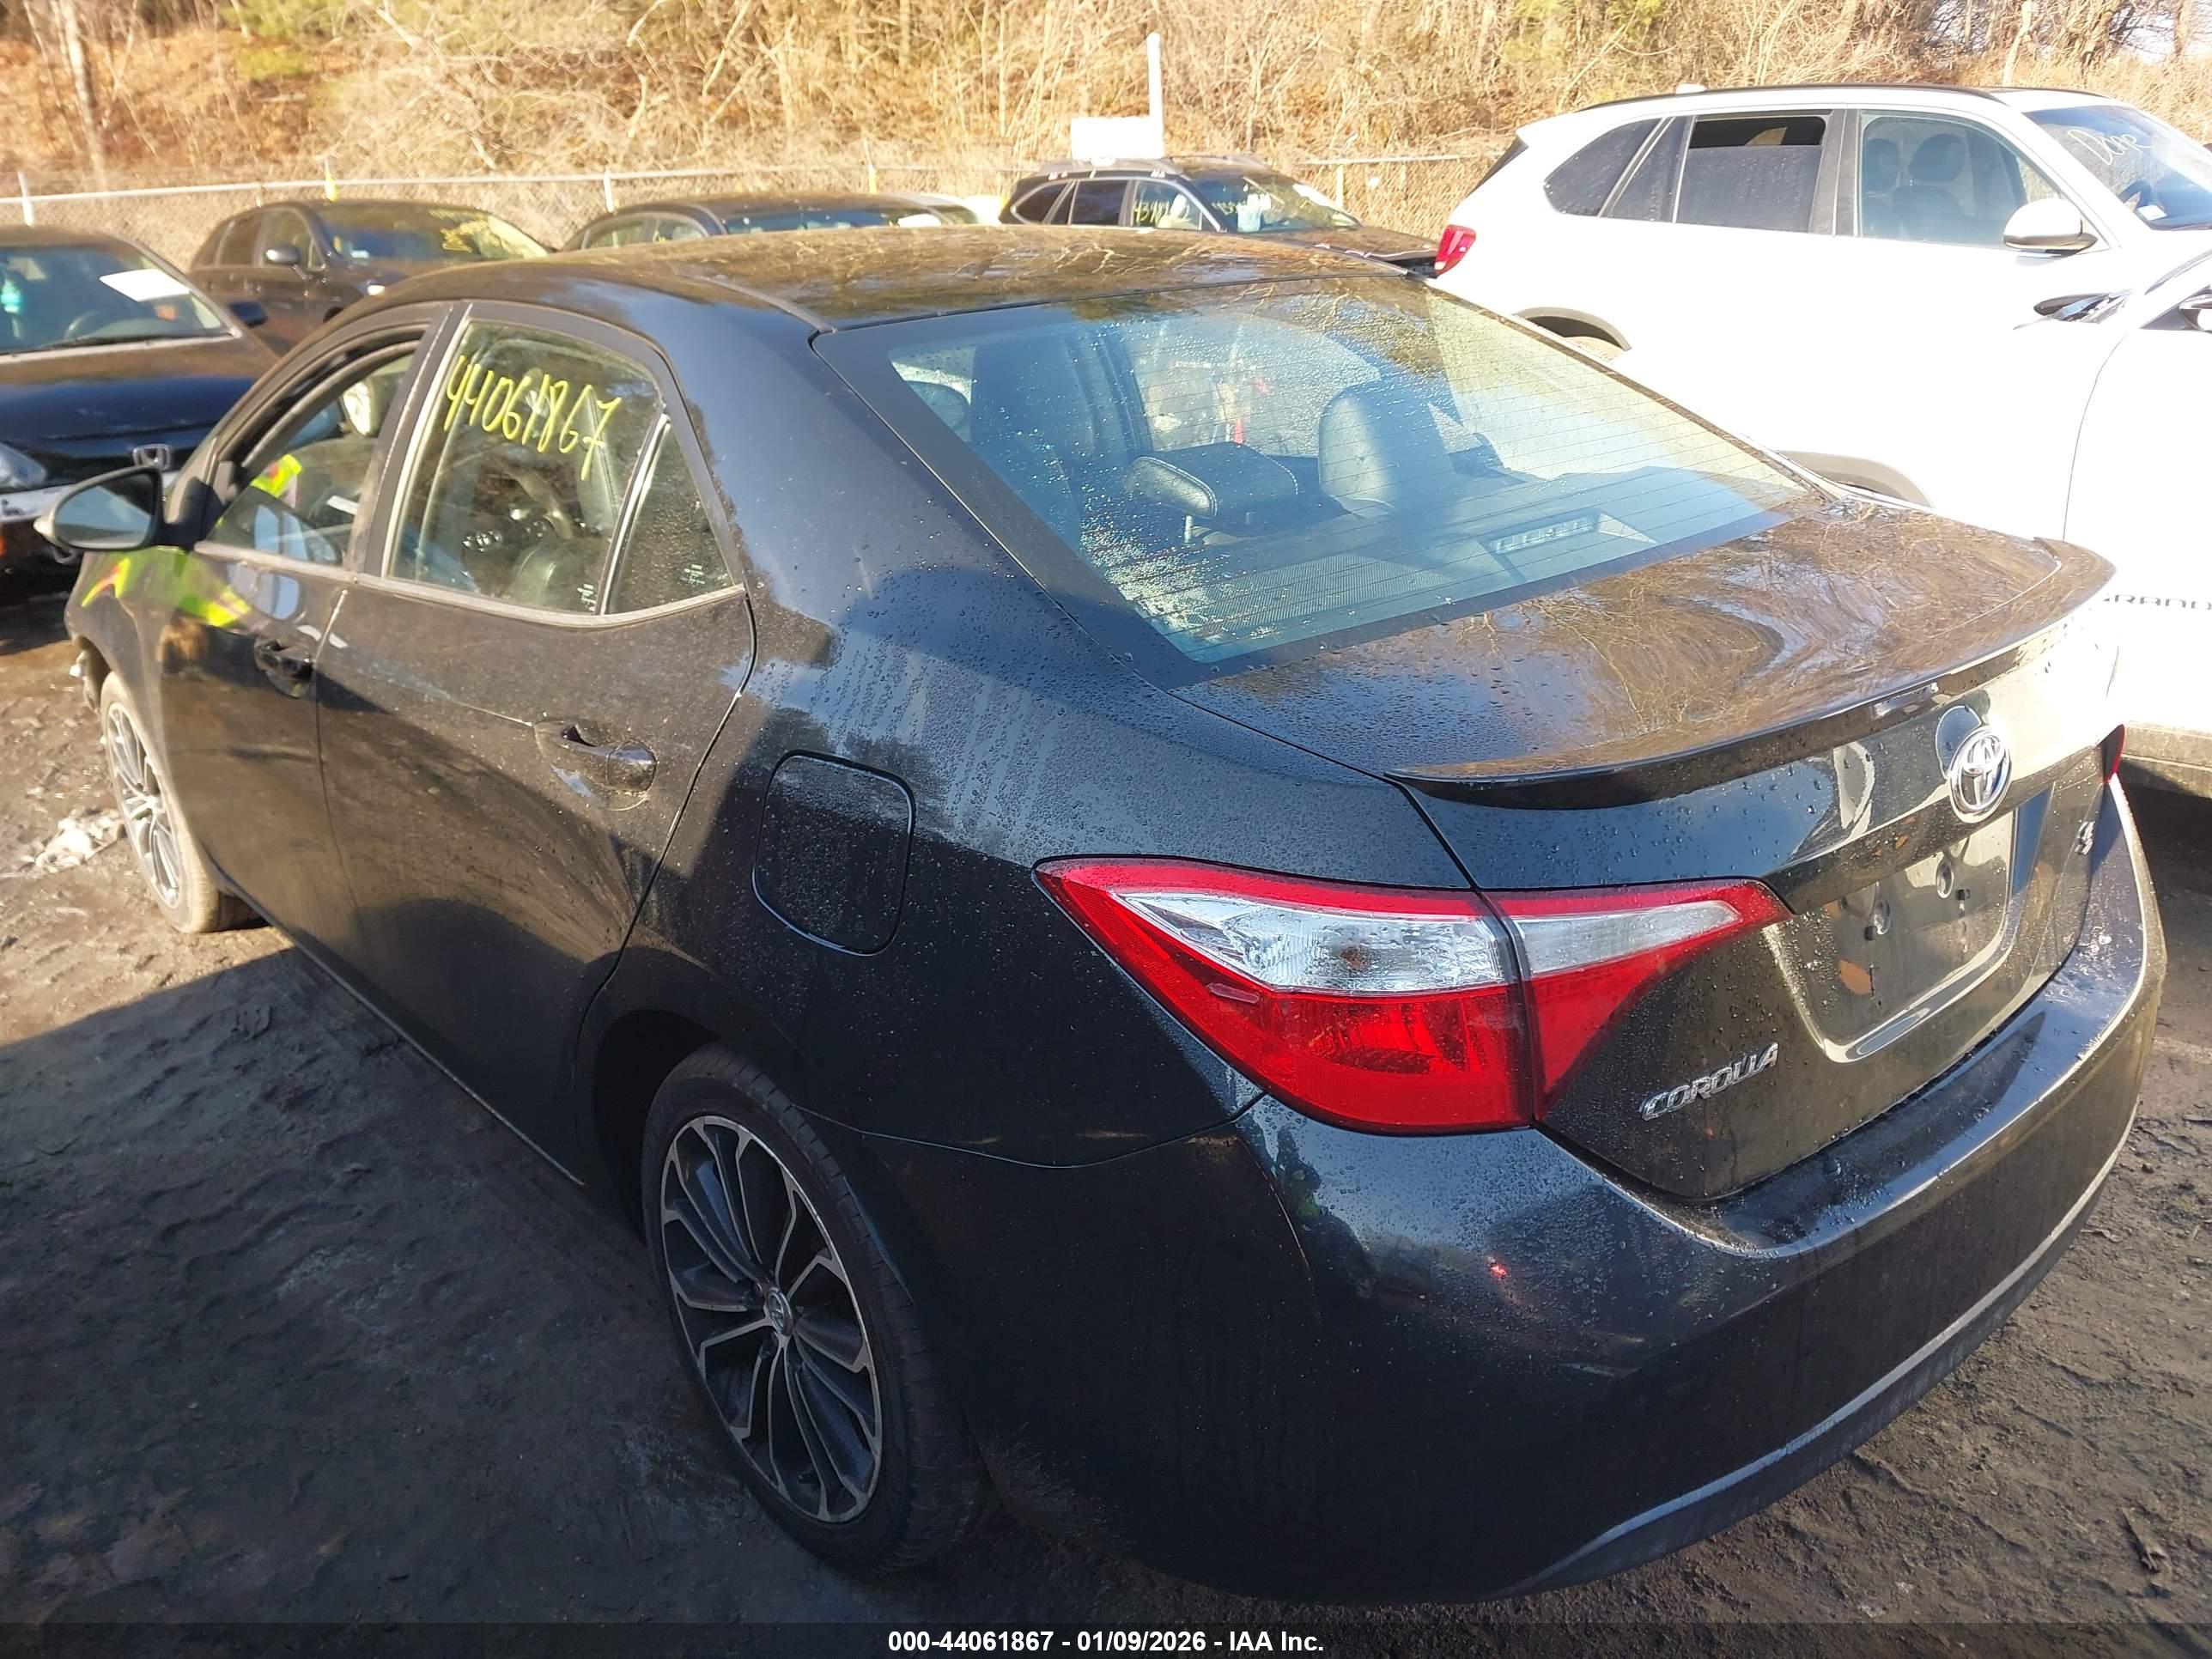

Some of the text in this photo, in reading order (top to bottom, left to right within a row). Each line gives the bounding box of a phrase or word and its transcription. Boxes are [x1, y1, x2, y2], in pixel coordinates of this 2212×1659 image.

[443, 355, 622, 481] 44061867
[2103, 594, 2212, 611] RAND
[1638, 1042, 1778, 1121] COROLLA
